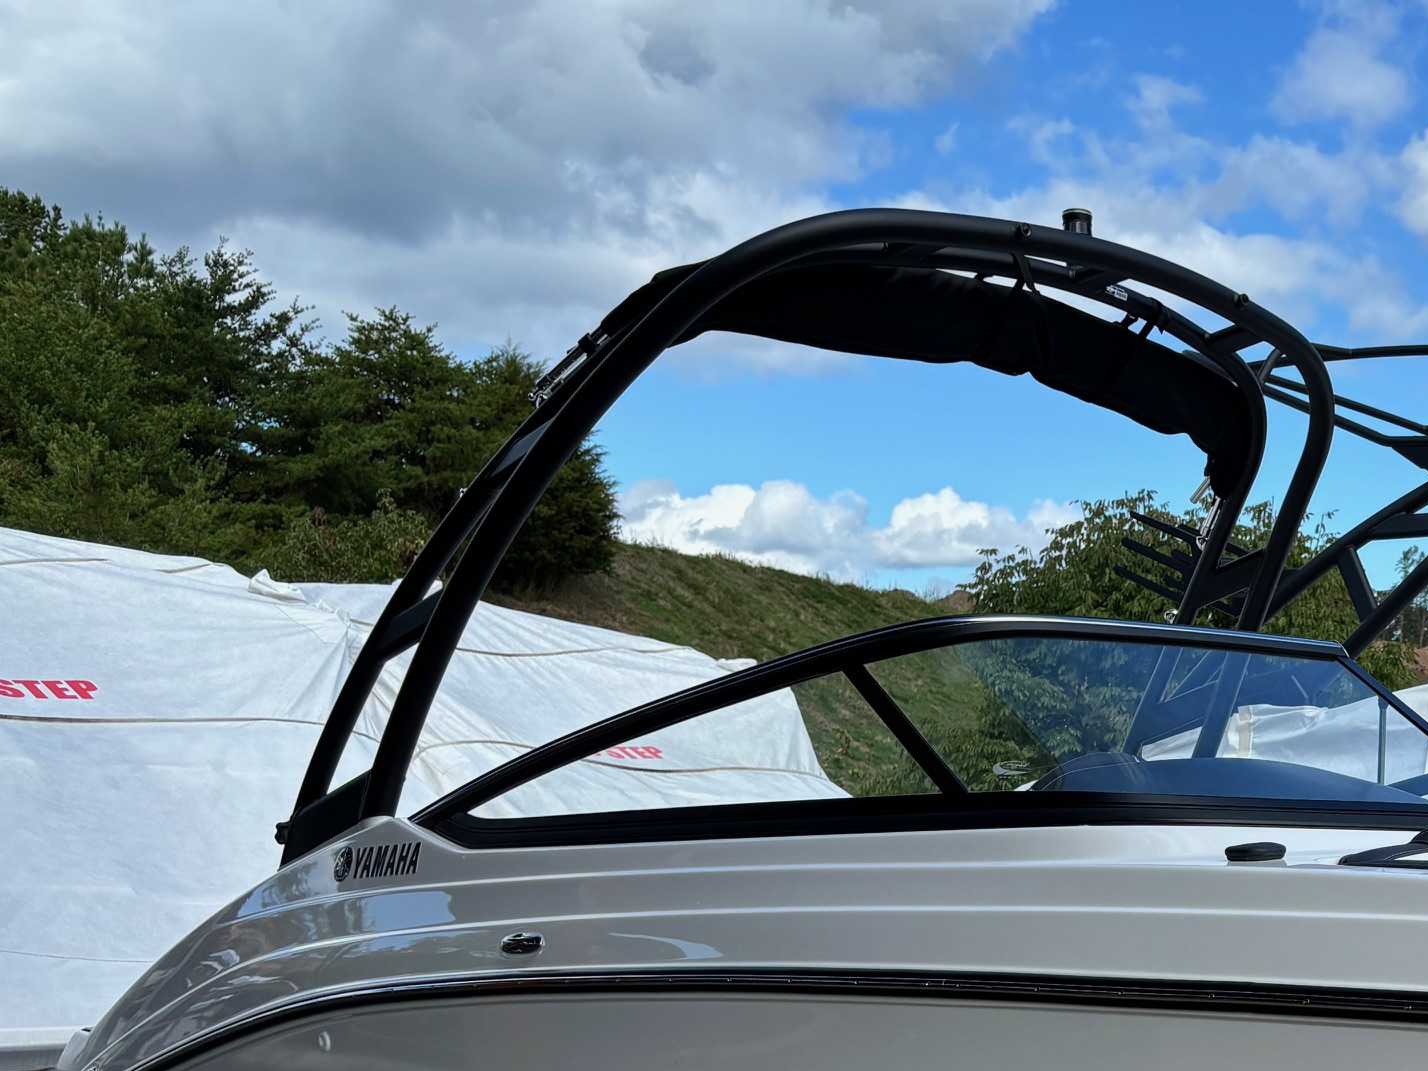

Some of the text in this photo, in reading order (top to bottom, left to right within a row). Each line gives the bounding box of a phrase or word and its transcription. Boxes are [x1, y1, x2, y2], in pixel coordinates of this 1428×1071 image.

[0, 679, 98, 700] STEP
[607, 745, 663, 759] STEP
[353, 841, 422, 879] YAMAHA
